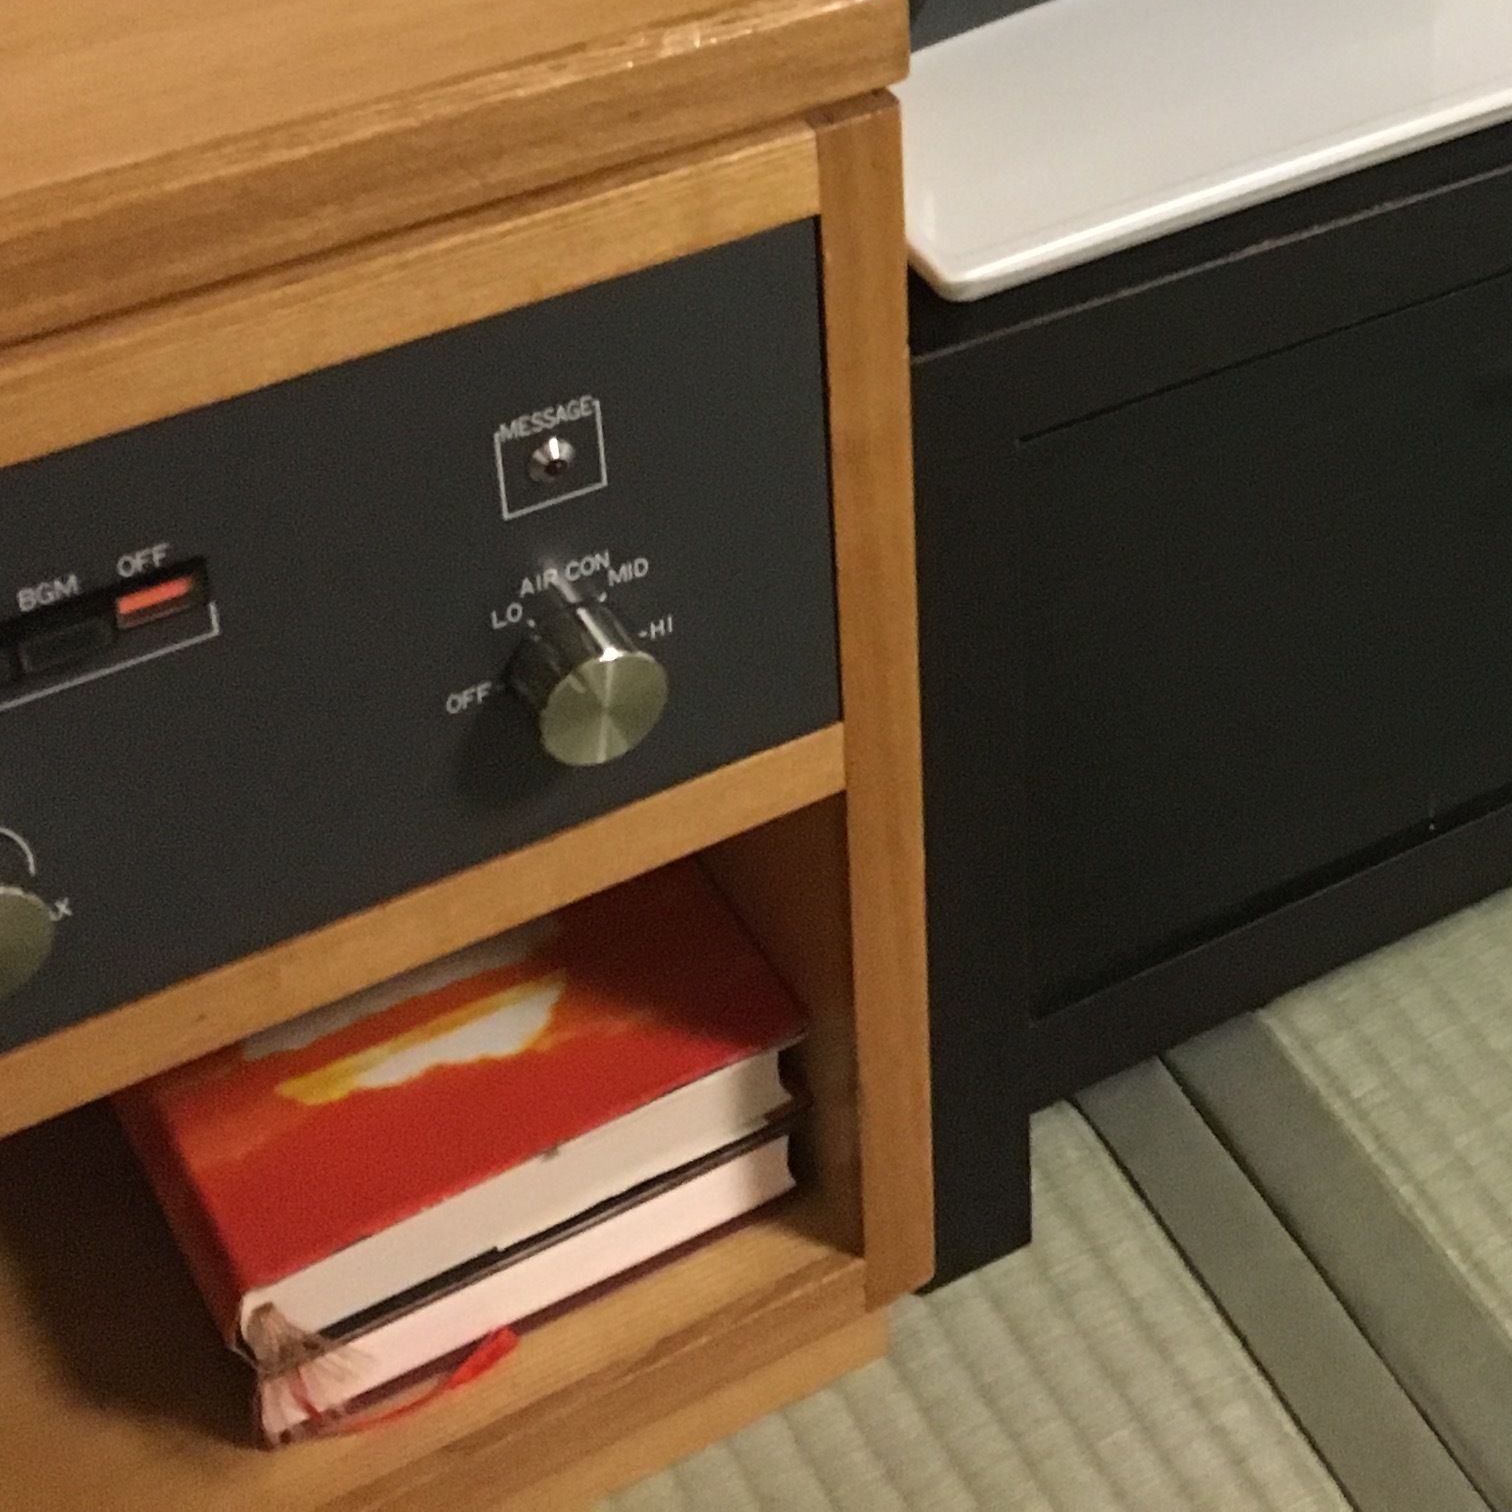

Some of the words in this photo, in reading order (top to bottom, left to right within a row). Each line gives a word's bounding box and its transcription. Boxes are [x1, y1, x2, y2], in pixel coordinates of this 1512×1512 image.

[499, 394, 594, 443] MESSAGE
[116, 543, 170, 578] OFF
[519, 567, 559, 598] AIR
[564, 549, 611, 582] CON
[607, 557, 650, 587] MID
[17, 573, 80, 612] BGM
[490, 601, 523, 630] LO
[445, 680, 493, 715] OFF
